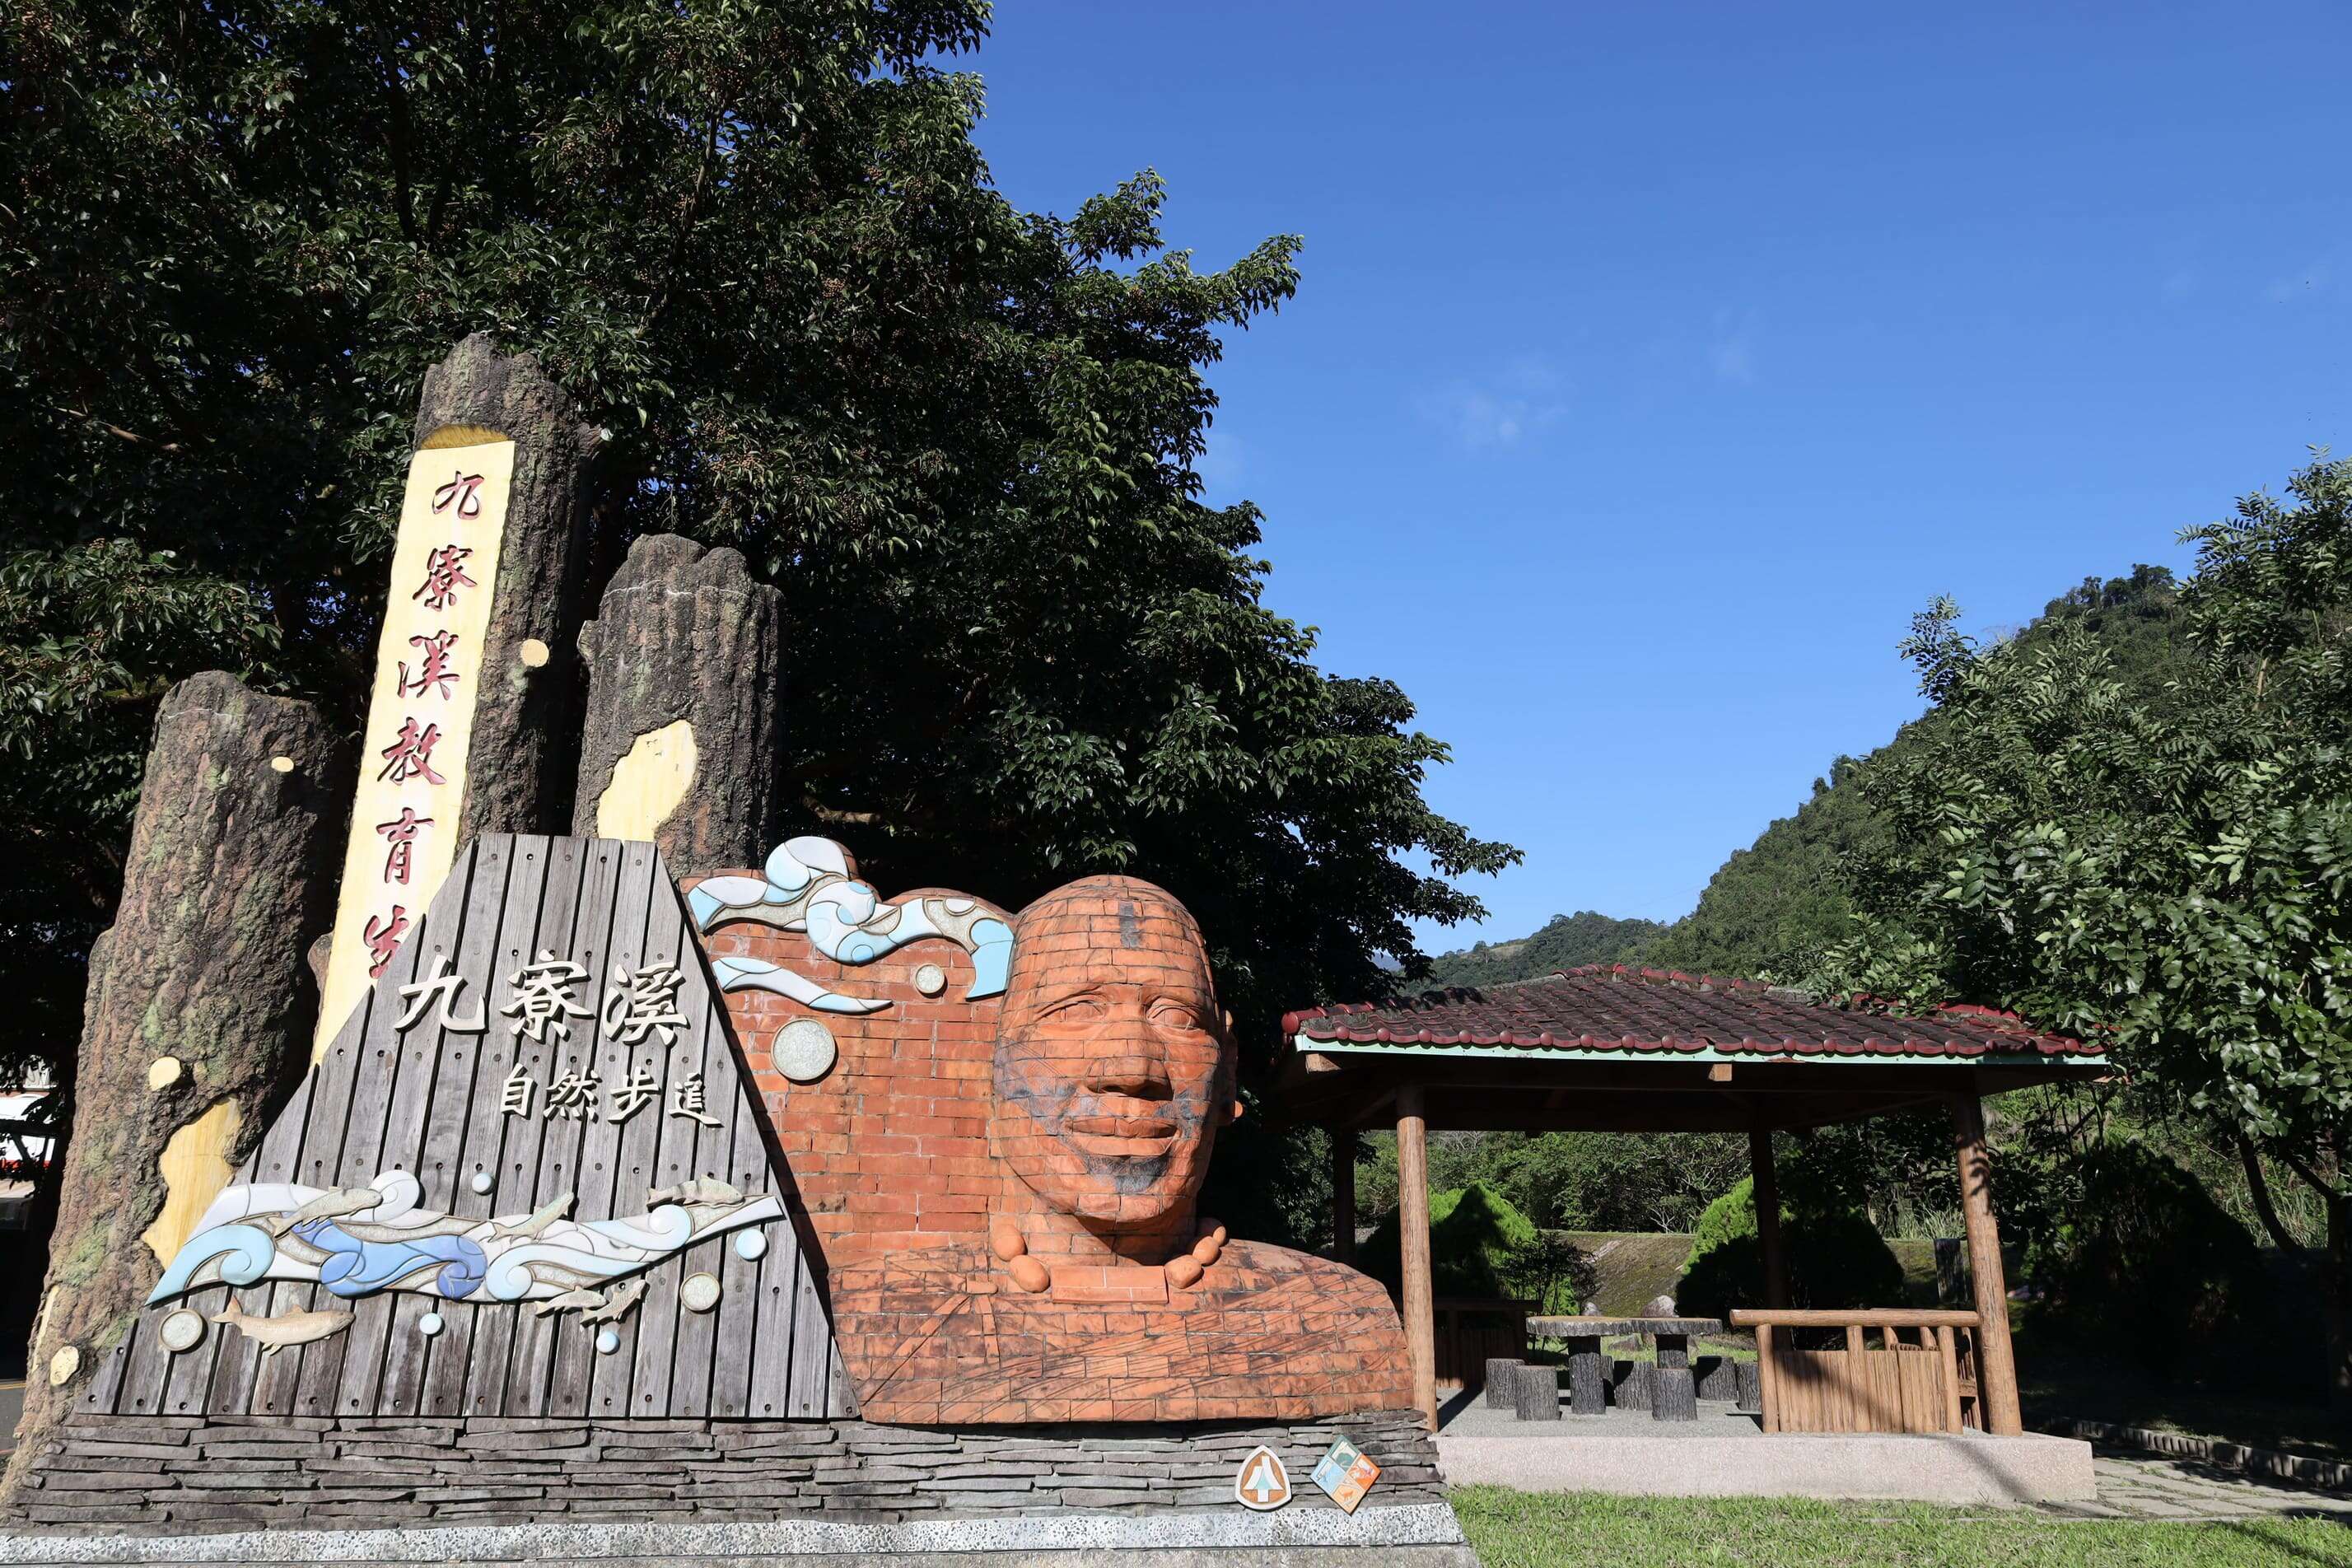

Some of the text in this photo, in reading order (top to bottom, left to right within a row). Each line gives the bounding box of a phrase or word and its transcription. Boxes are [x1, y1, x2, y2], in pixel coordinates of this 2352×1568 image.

[394, 948, 692, 1048] 九寮溪
[500, 1062, 725, 1128] 自然步道
